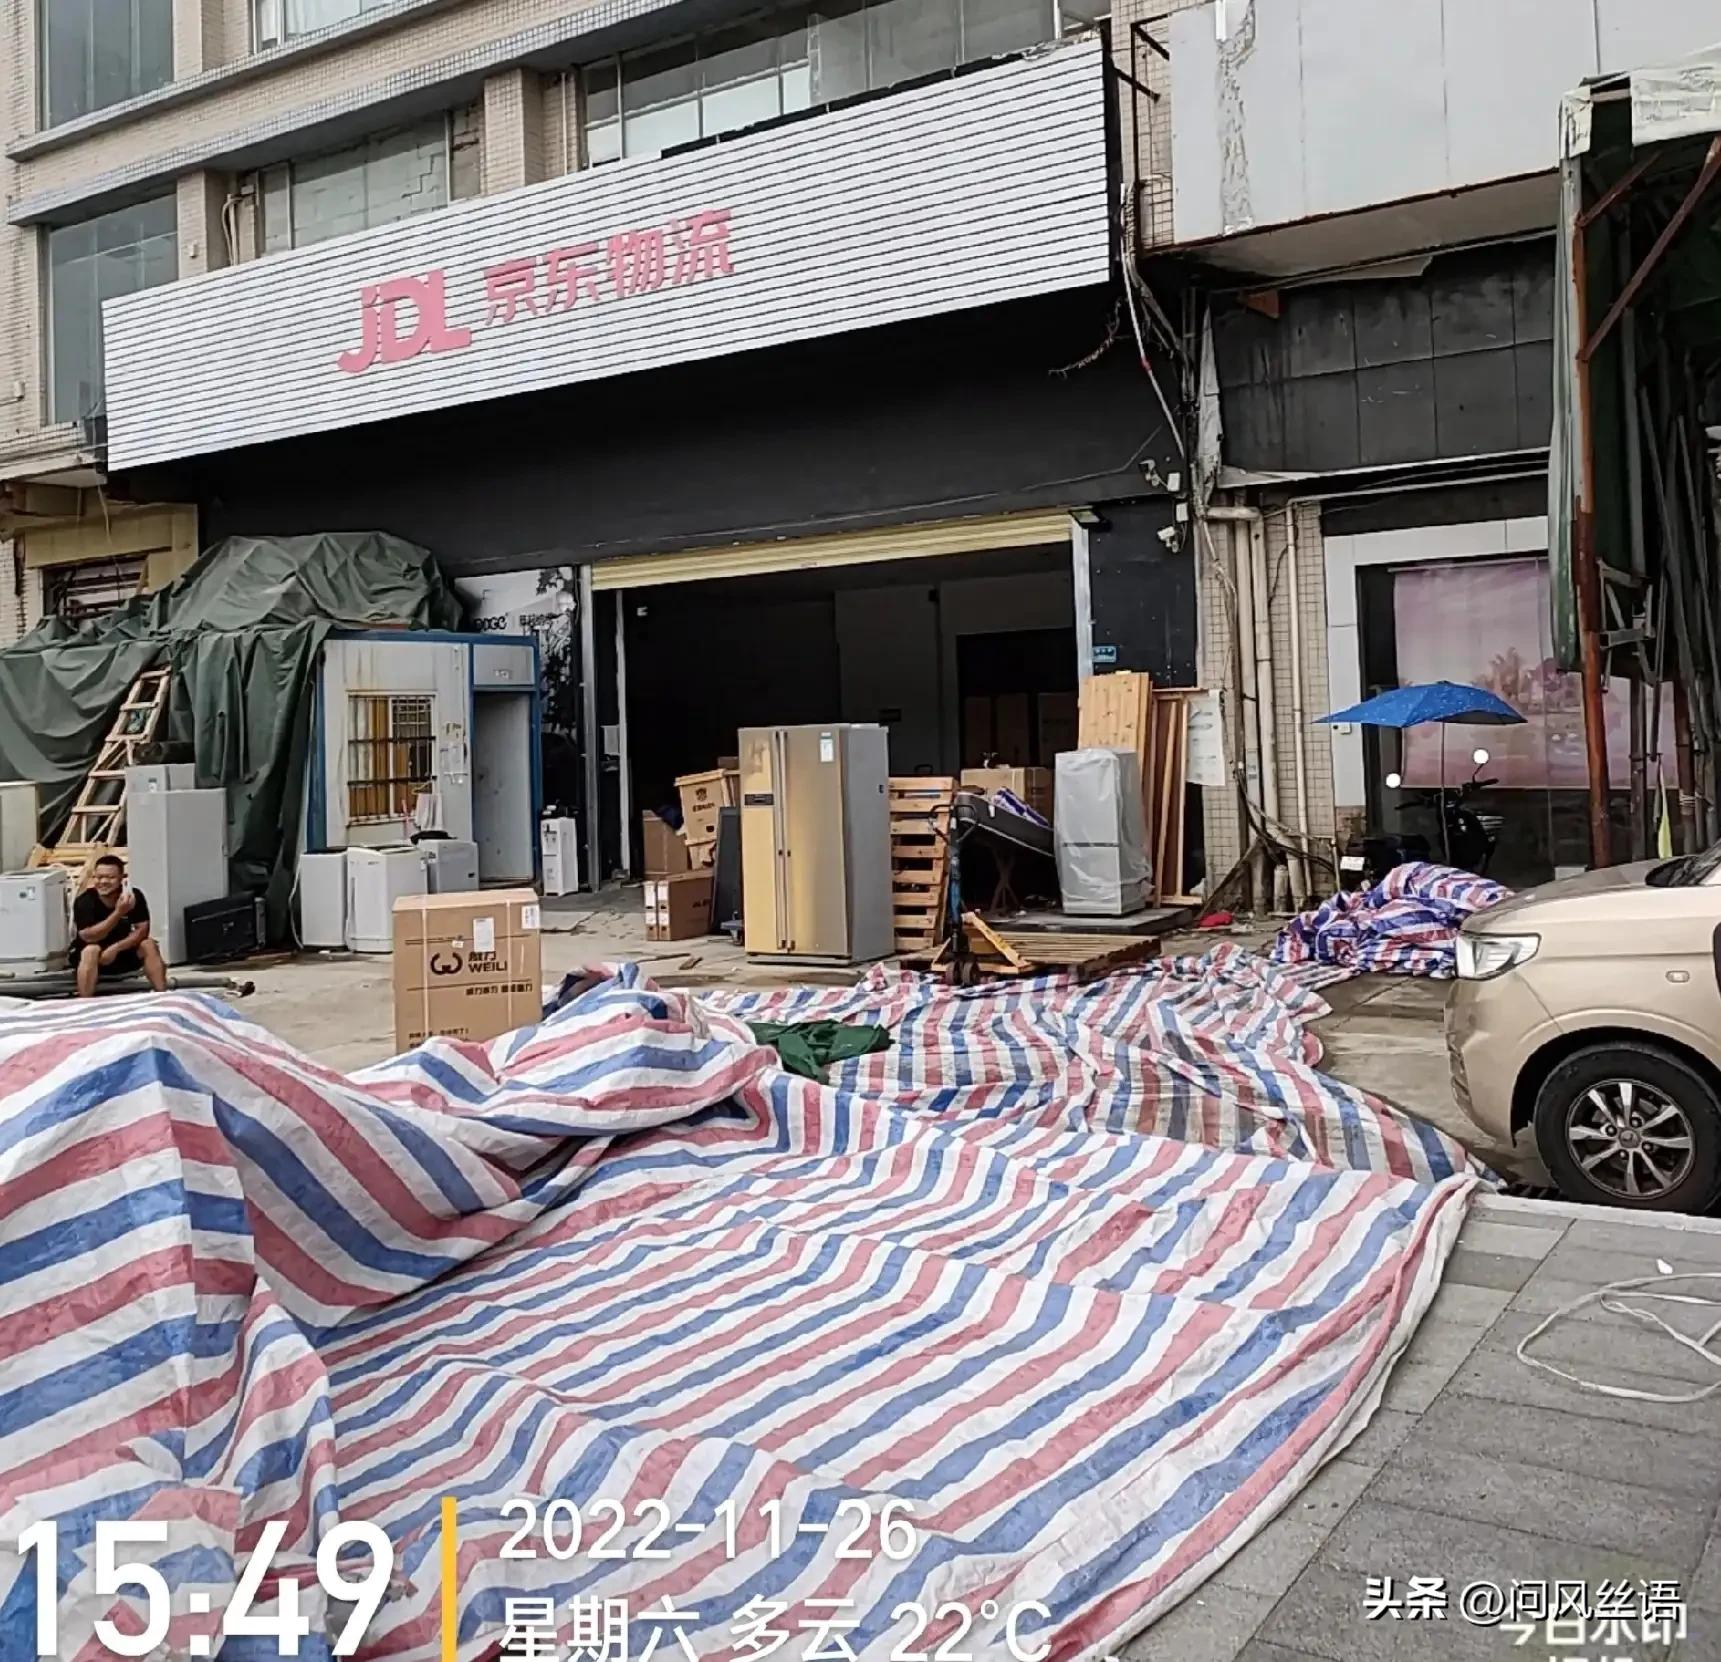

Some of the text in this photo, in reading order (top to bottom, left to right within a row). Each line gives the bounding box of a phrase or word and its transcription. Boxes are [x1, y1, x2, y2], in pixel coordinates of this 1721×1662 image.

[483, 208, 735, 326] 京东物流
[338, 269, 472, 373] JDL
[468, 960, 508, 973] WEILI
